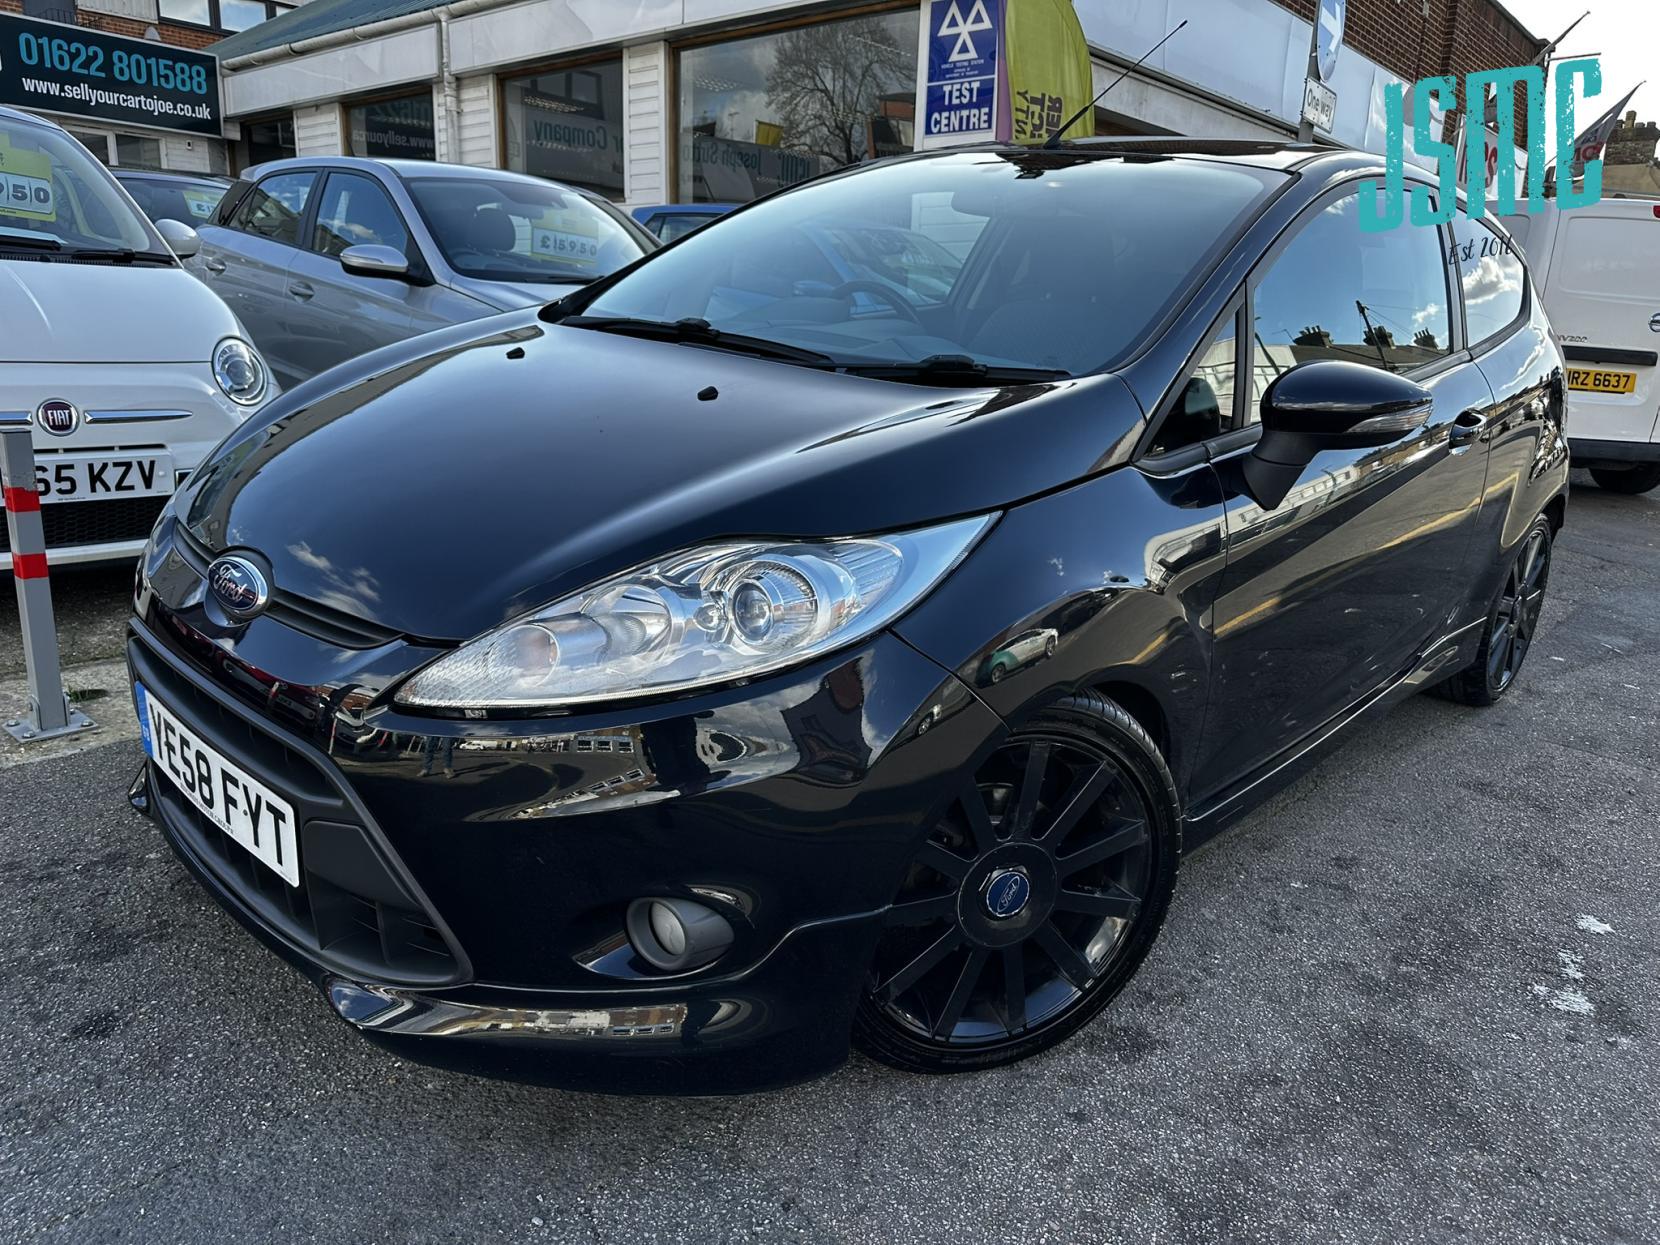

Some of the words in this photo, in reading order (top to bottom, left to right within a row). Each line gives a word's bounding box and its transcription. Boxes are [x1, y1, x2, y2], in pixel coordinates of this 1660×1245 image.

[19, 32, 106, 78] 01622
[112, 50, 207, 95] 801588
[21, 77, 211, 120] www.sellyourcartojoe.co.uk
[943, 81, 980, 106] TEST
[931, 107, 989, 133] CENTRE
[1593, 373, 1631, 389] 6637
[47, 409, 71, 426] FIAT
[88, 460, 156, 493] KZV
[213, 563, 248, 603] Ford
[150, 703, 214, 811] YE58
[220, 767, 287, 867] FYT
